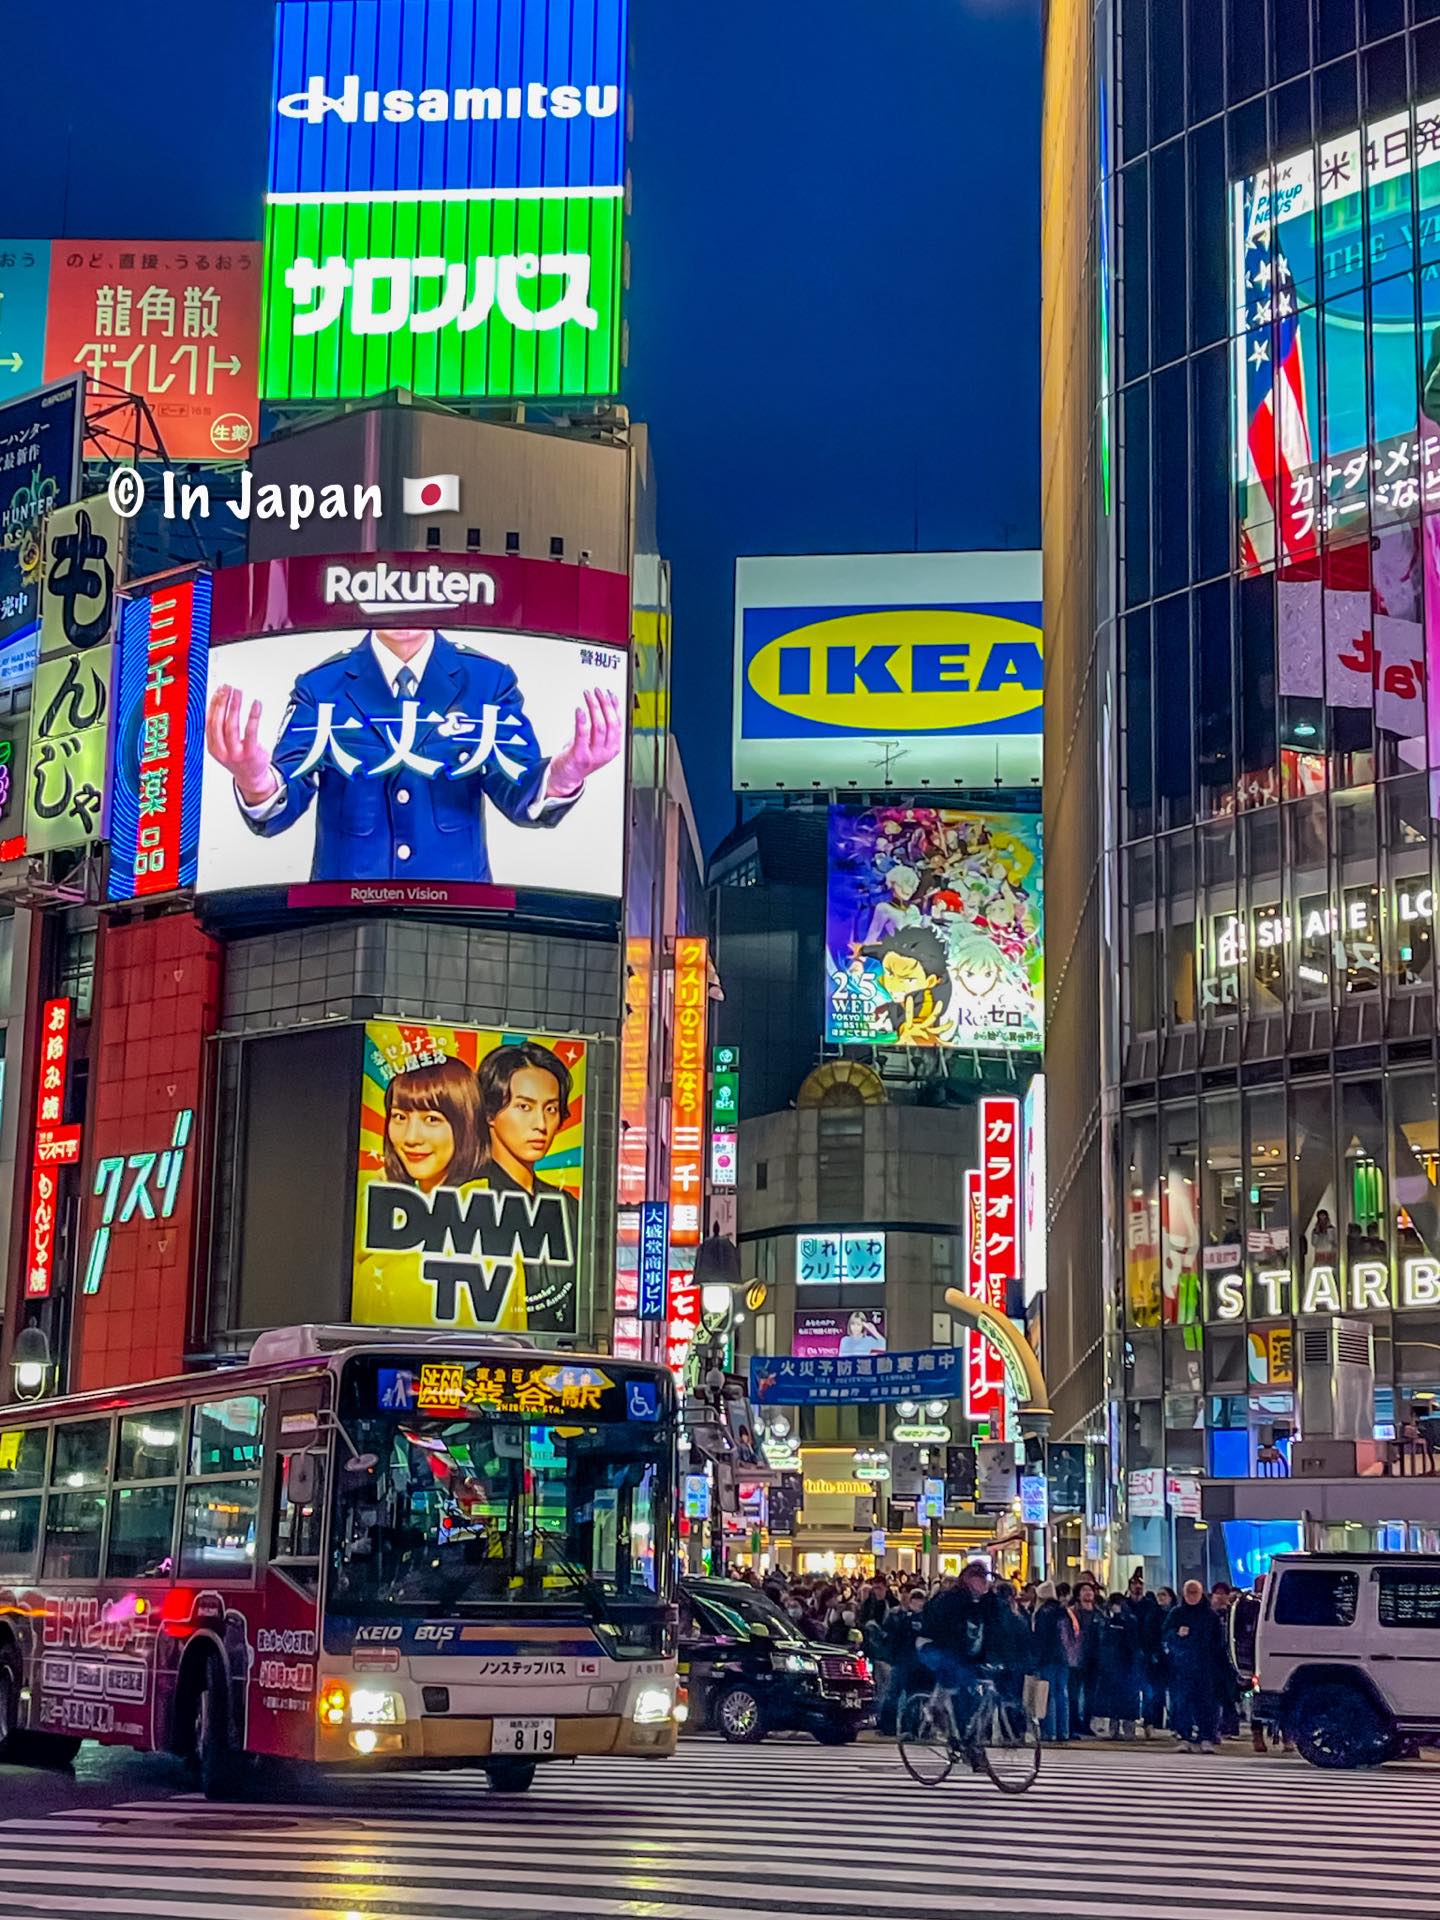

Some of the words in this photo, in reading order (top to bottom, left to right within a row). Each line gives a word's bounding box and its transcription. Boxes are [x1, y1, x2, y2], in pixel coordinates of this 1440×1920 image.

[277, 75, 618, 123] Hisamitsu
[67, 253, 251, 270] のど、直接、うるおう
[95, 285, 220, 338] 龍角散
[285, 253, 598, 335] サロンパス
[74, 343, 241, 395] ダイレクト
[213, 424, 248, 441] 生薬
[2, 497, 53, 528] HUNTER
[326, 563, 496, 605] Rakuten
[580, 649, 621, 670] 警視庁
[778, 642, 1043, 695] IKEA
[132, 598, 179, 876] 三千里薬品
[289, 700, 529, 784] 大丈夫
[350, 886, 404, 902] Rakuten
[407, 887, 448, 900] Vision
[678, 945, 702, 1112] クスリのことなら
[831, 1013, 860, 1021] TOKYO
[832, 1000, 876, 1014] WED
[41, 1006, 66, 1120] お好み焼
[83, 1109, 193, 1295] クスリ
[672, 1126, 701, 1231] 三千里
[986, 1119, 1014, 1256] カラオケ
[28, 1172, 53, 1293] もんじゃ焼
[366, 1186, 570, 1262] DMM
[821, 1239, 882, 1257] れいわ
[644, 1207, 664, 1315] 大盛堂商事ビル
[801, 1263, 882, 1279] クリニック
[422, 1261, 513, 1322] TV
[1216, 1257, 1440, 1319] STARB
[780, 1353, 955, 1377] 火災予防運動実施中
[463, 1380, 602, 1409] 渋谷駅
[355, 1626, 402, 1640] KEIO
[414, 1626, 455, 1648] BUS
[479, 1661, 566, 1676] ノンステップバス
